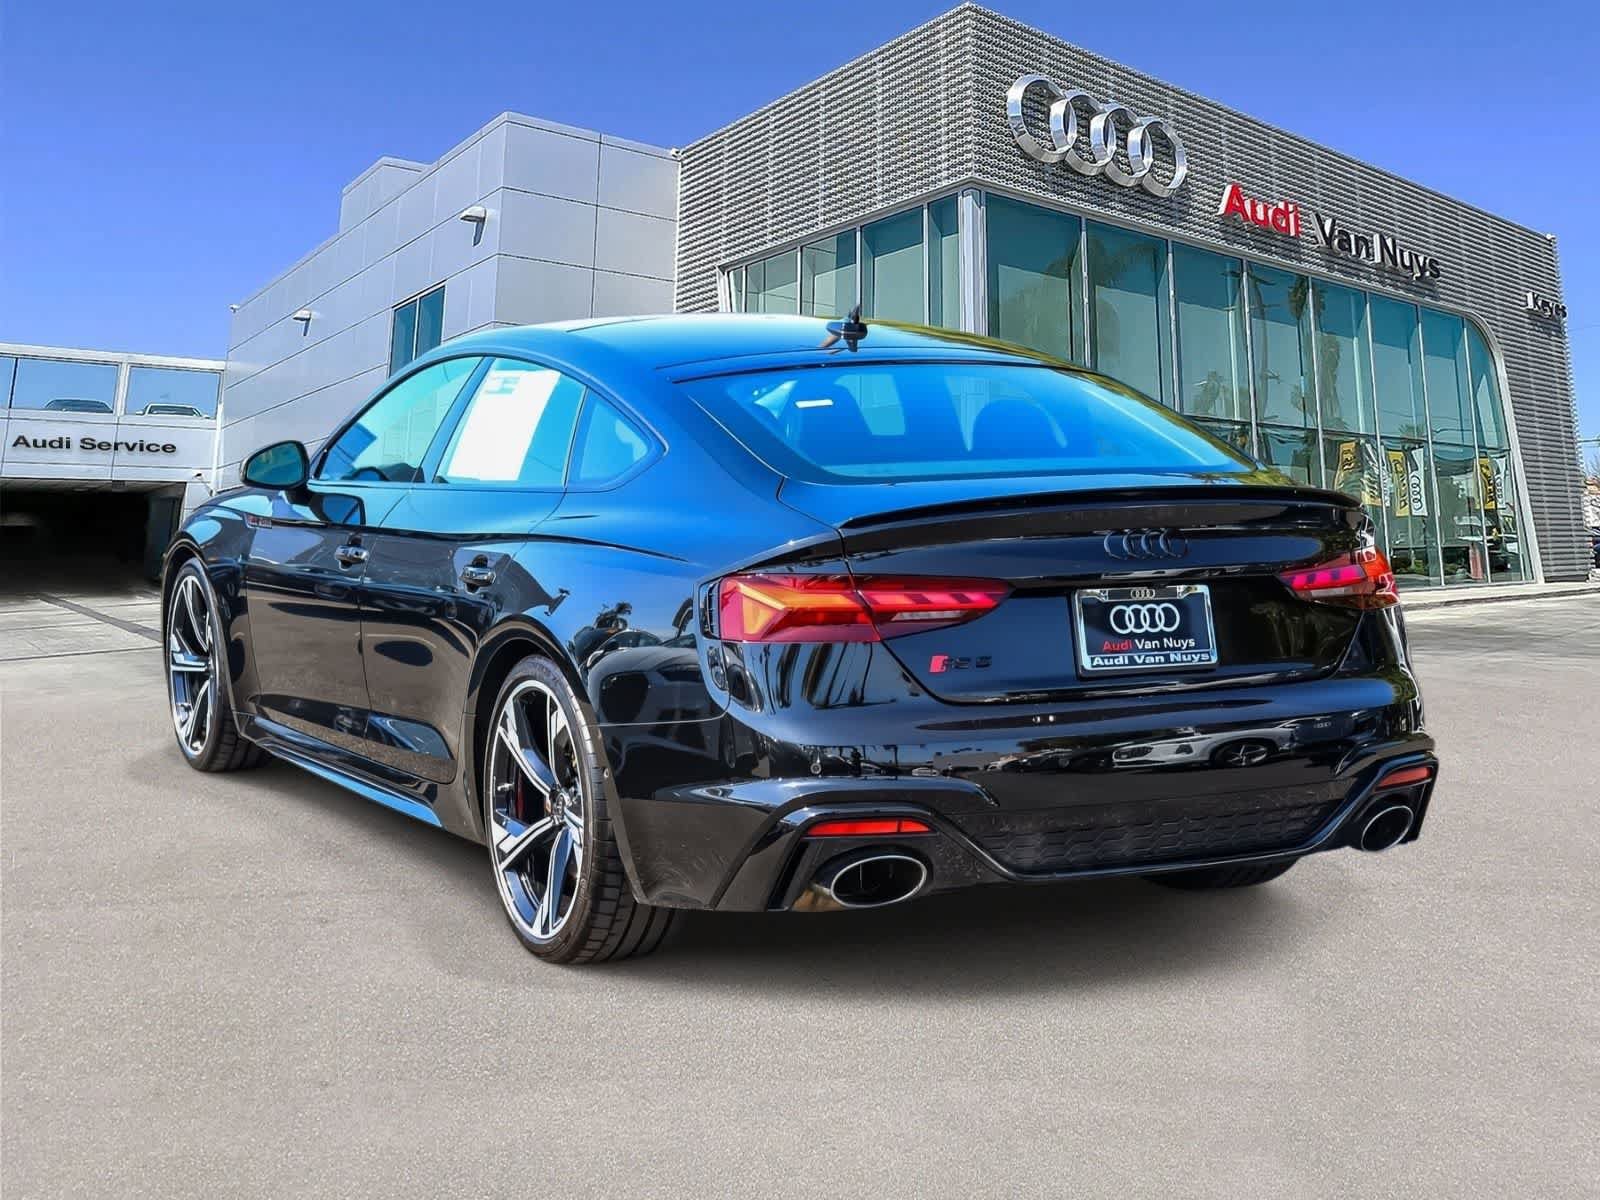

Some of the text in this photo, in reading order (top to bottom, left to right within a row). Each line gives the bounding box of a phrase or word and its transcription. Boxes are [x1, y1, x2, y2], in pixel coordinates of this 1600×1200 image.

[1217, 182, 1441, 280] Audi Van Nuys
[12, 434, 177, 453] Audi Service
[1102, 636, 1196, 652] Audi Van Nuys
[1092, 651, 1210, 666] Audi Van Nuys
